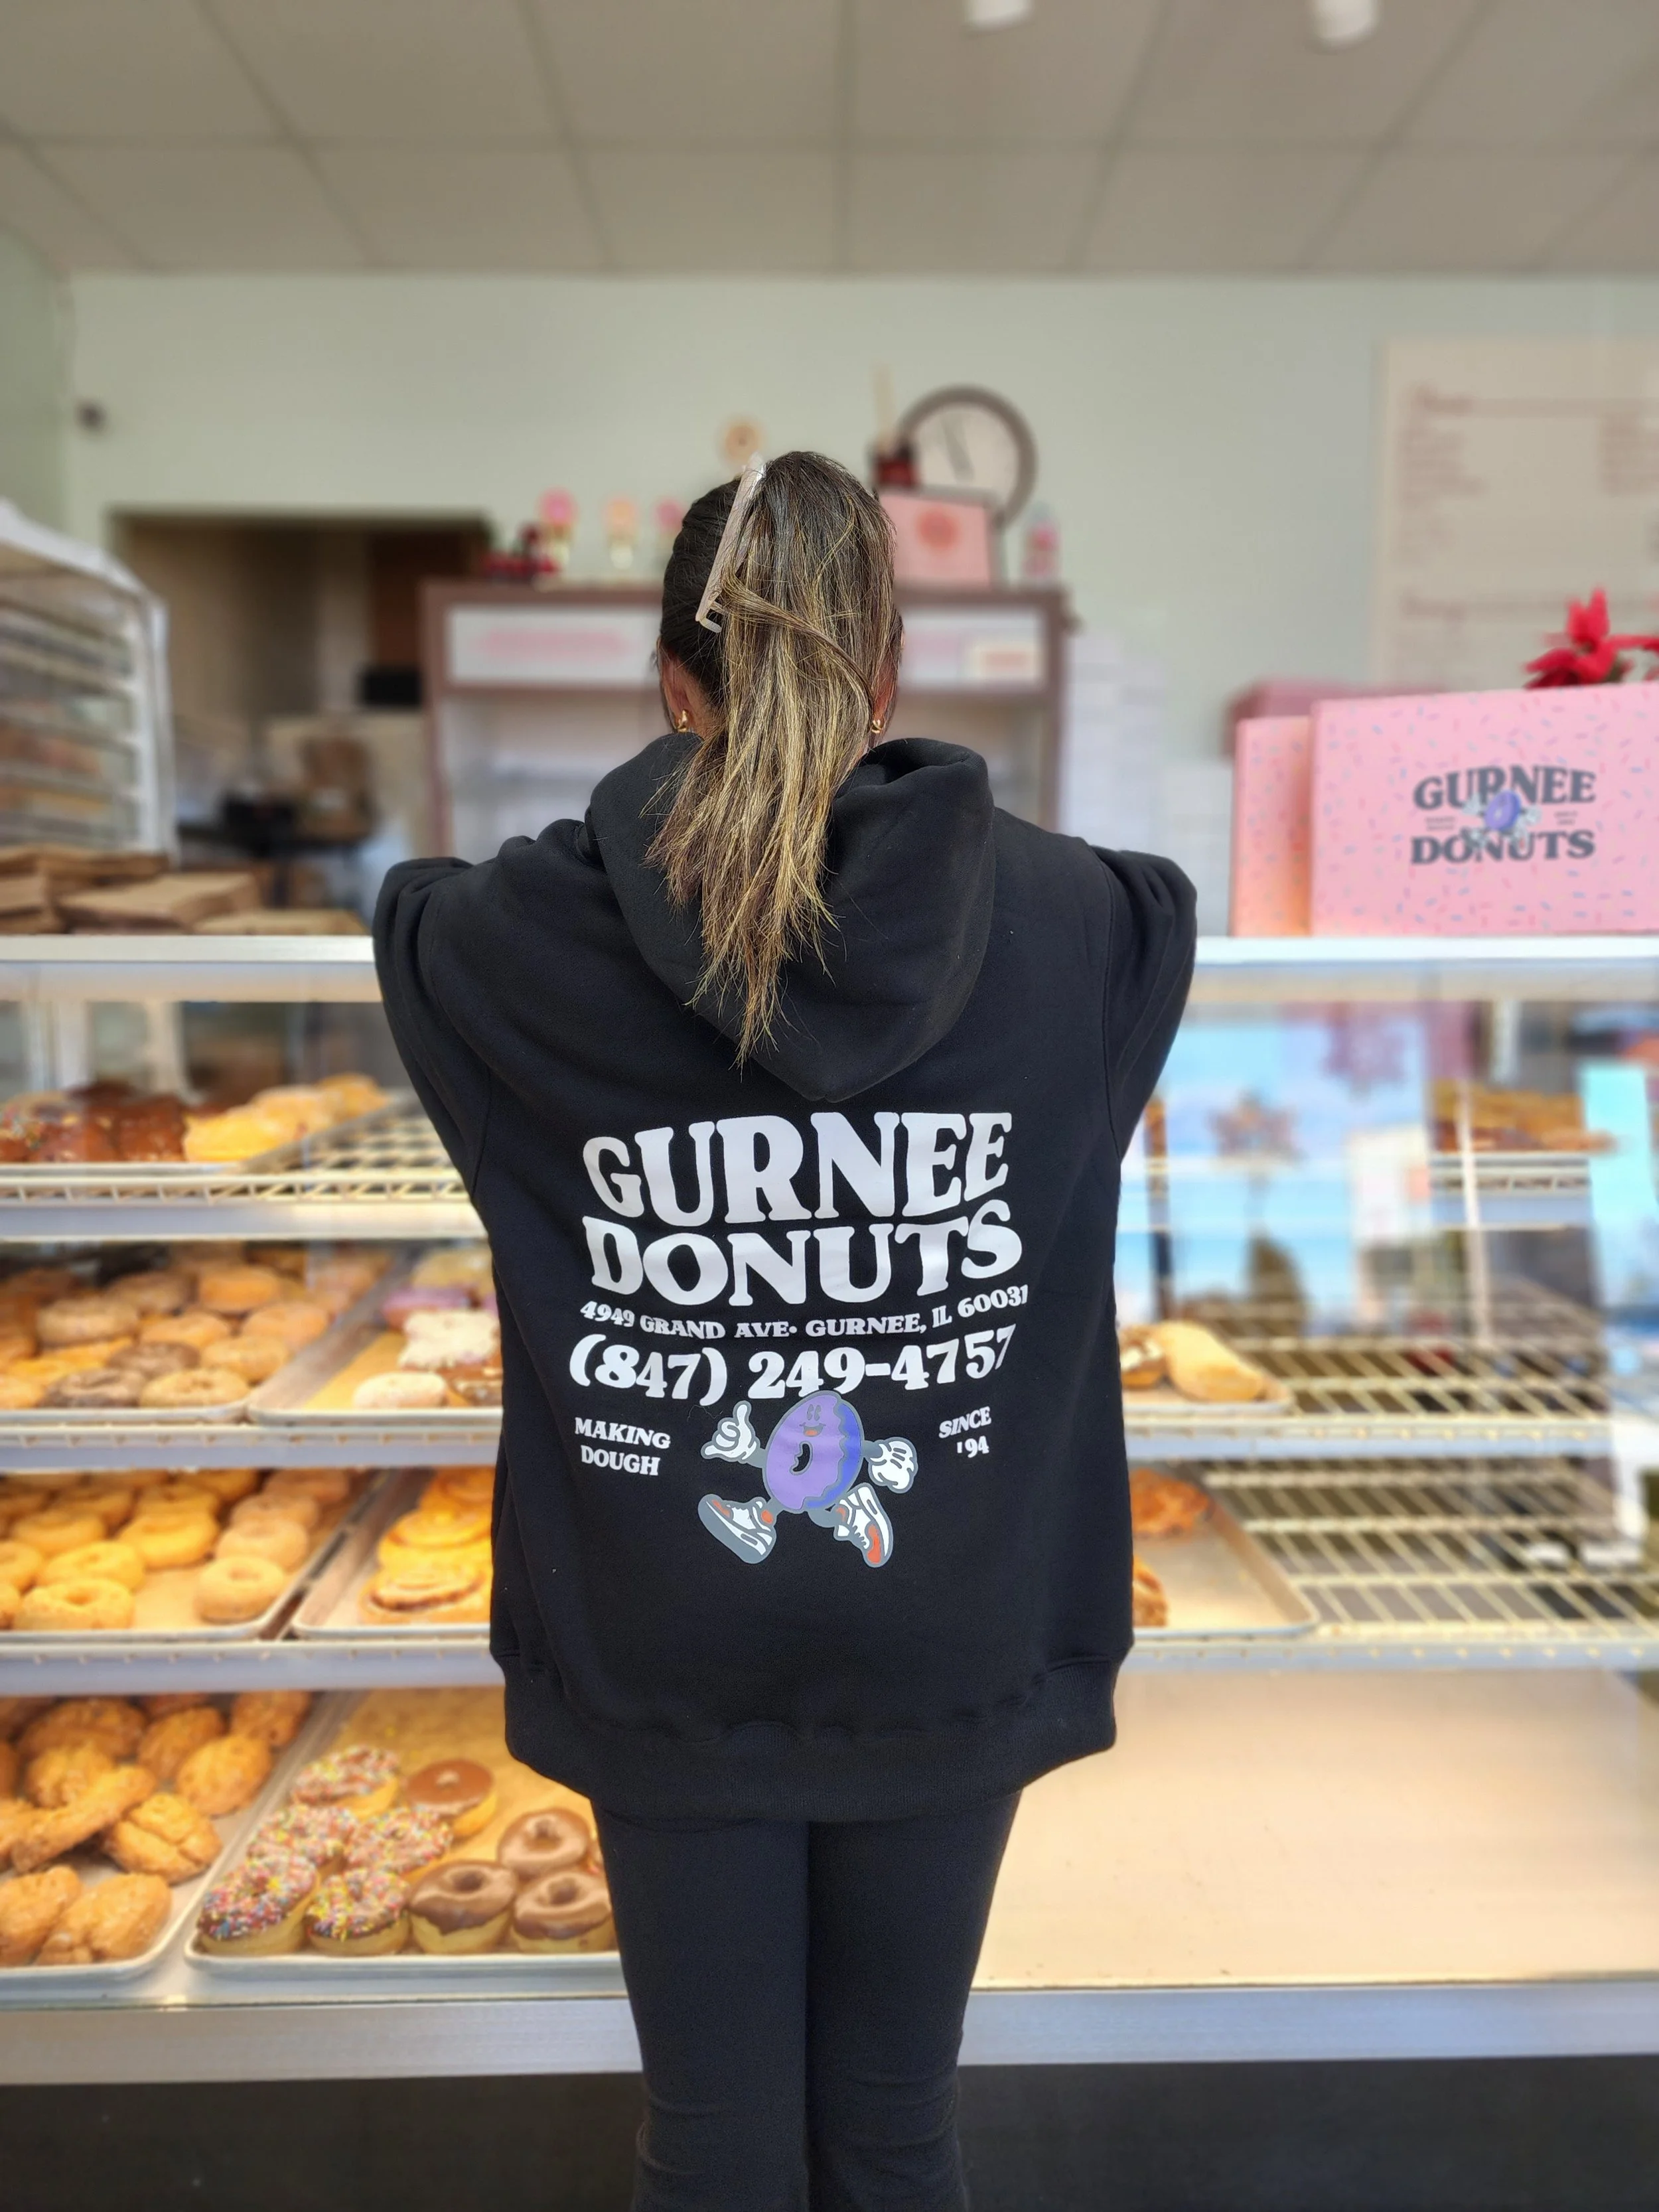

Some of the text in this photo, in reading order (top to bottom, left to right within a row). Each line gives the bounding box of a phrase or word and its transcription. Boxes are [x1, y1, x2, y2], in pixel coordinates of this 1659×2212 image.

[1412, 764, 1597, 810] GURNEE
[1410, 828, 1596, 865] DONUTS
[582, 1112, 1013, 1227] GURNEE
[582, 1199, 1023, 1307] DONUTS
[580, 1300, 635, 1327] 4949
[639, 1315, 726, 1339] GRAND
[805, 1313, 927, 1337] GURNEE,
[931, 1305, 953, 1328] IL
[957, 1284, 1029, 1318] 60031
[569, 1323, 1017, 1406] (847) 249-4757
[575, 1417, 671, 1449] MAKING
[938, 1406, 992, 1439] SINCE
[581, 1445, 661, 1476] DOUGH
[956, 1435, 989, 1459] '94
